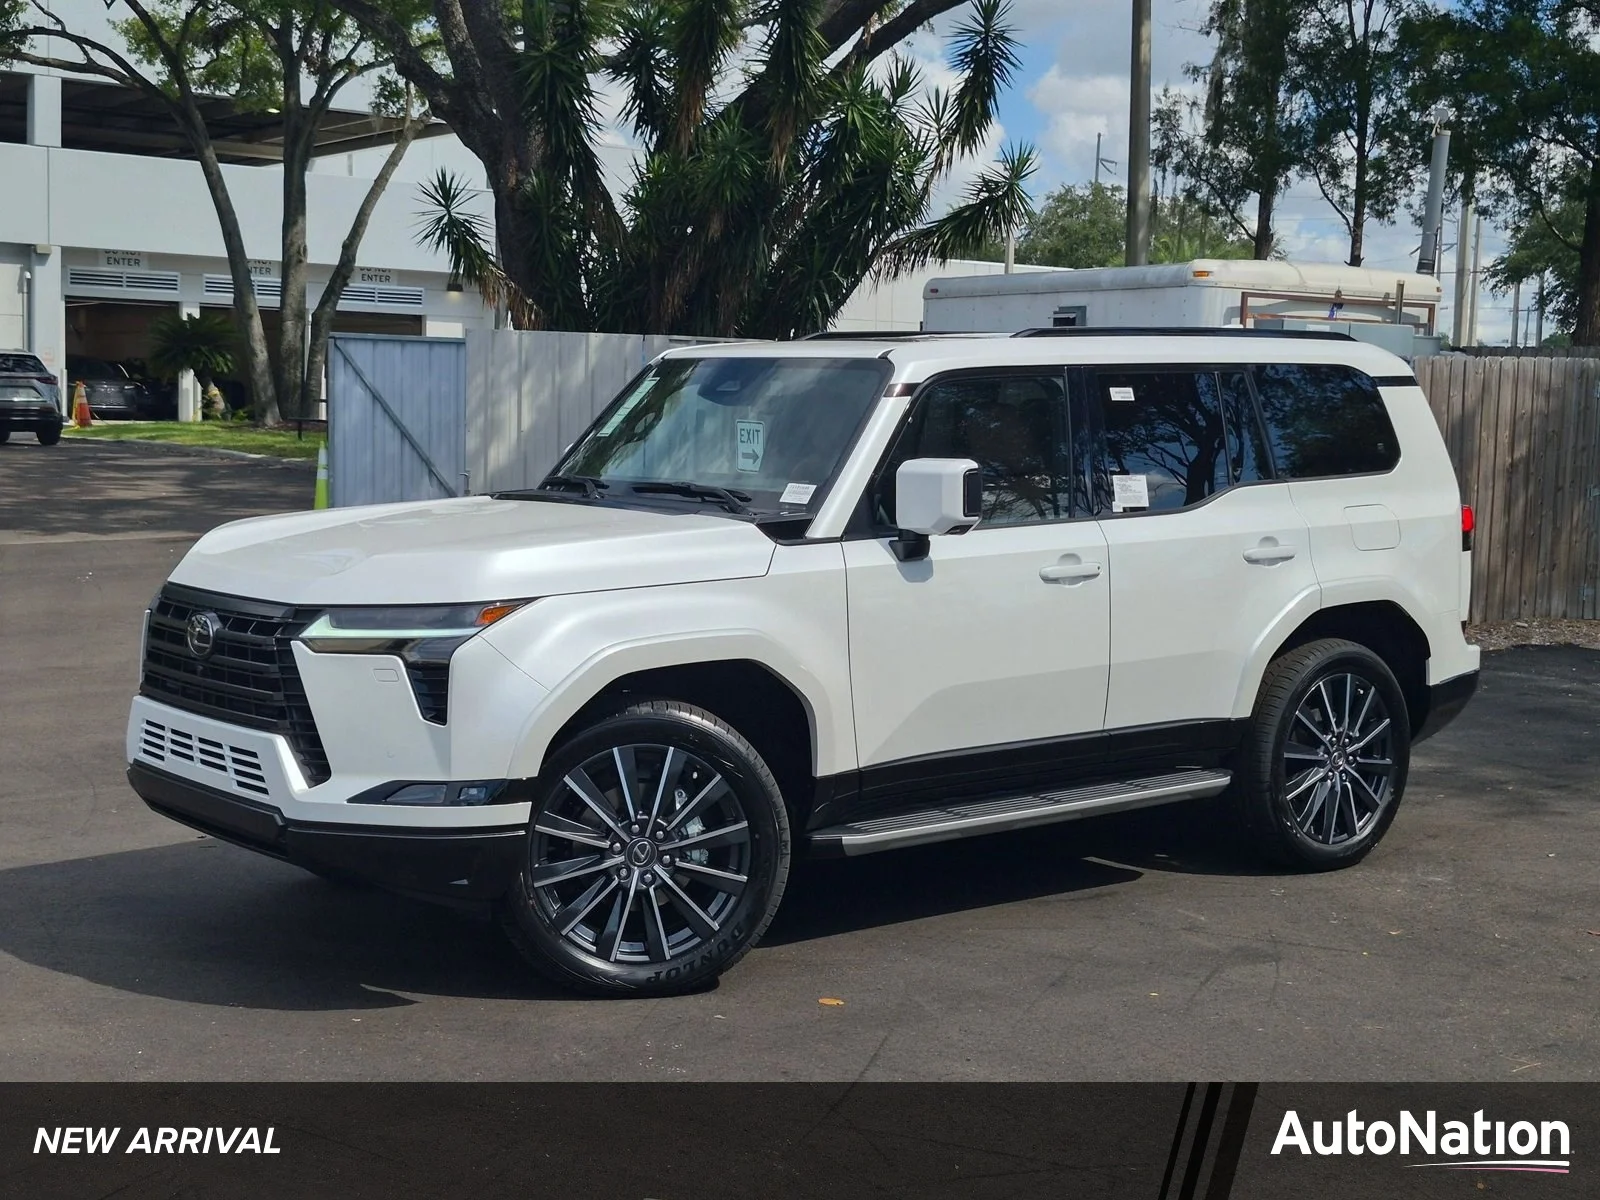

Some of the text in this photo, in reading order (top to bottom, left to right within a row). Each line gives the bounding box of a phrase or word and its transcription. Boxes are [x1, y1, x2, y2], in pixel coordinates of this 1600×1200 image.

[106, 256, 141, 267] ENTER
[248, 266, 272, 275] NTER
[361, 273, 391, 283] ENTER
[739, 428, 761, 445] EXIT
[645, 926, 744, 984] DUNLOP
